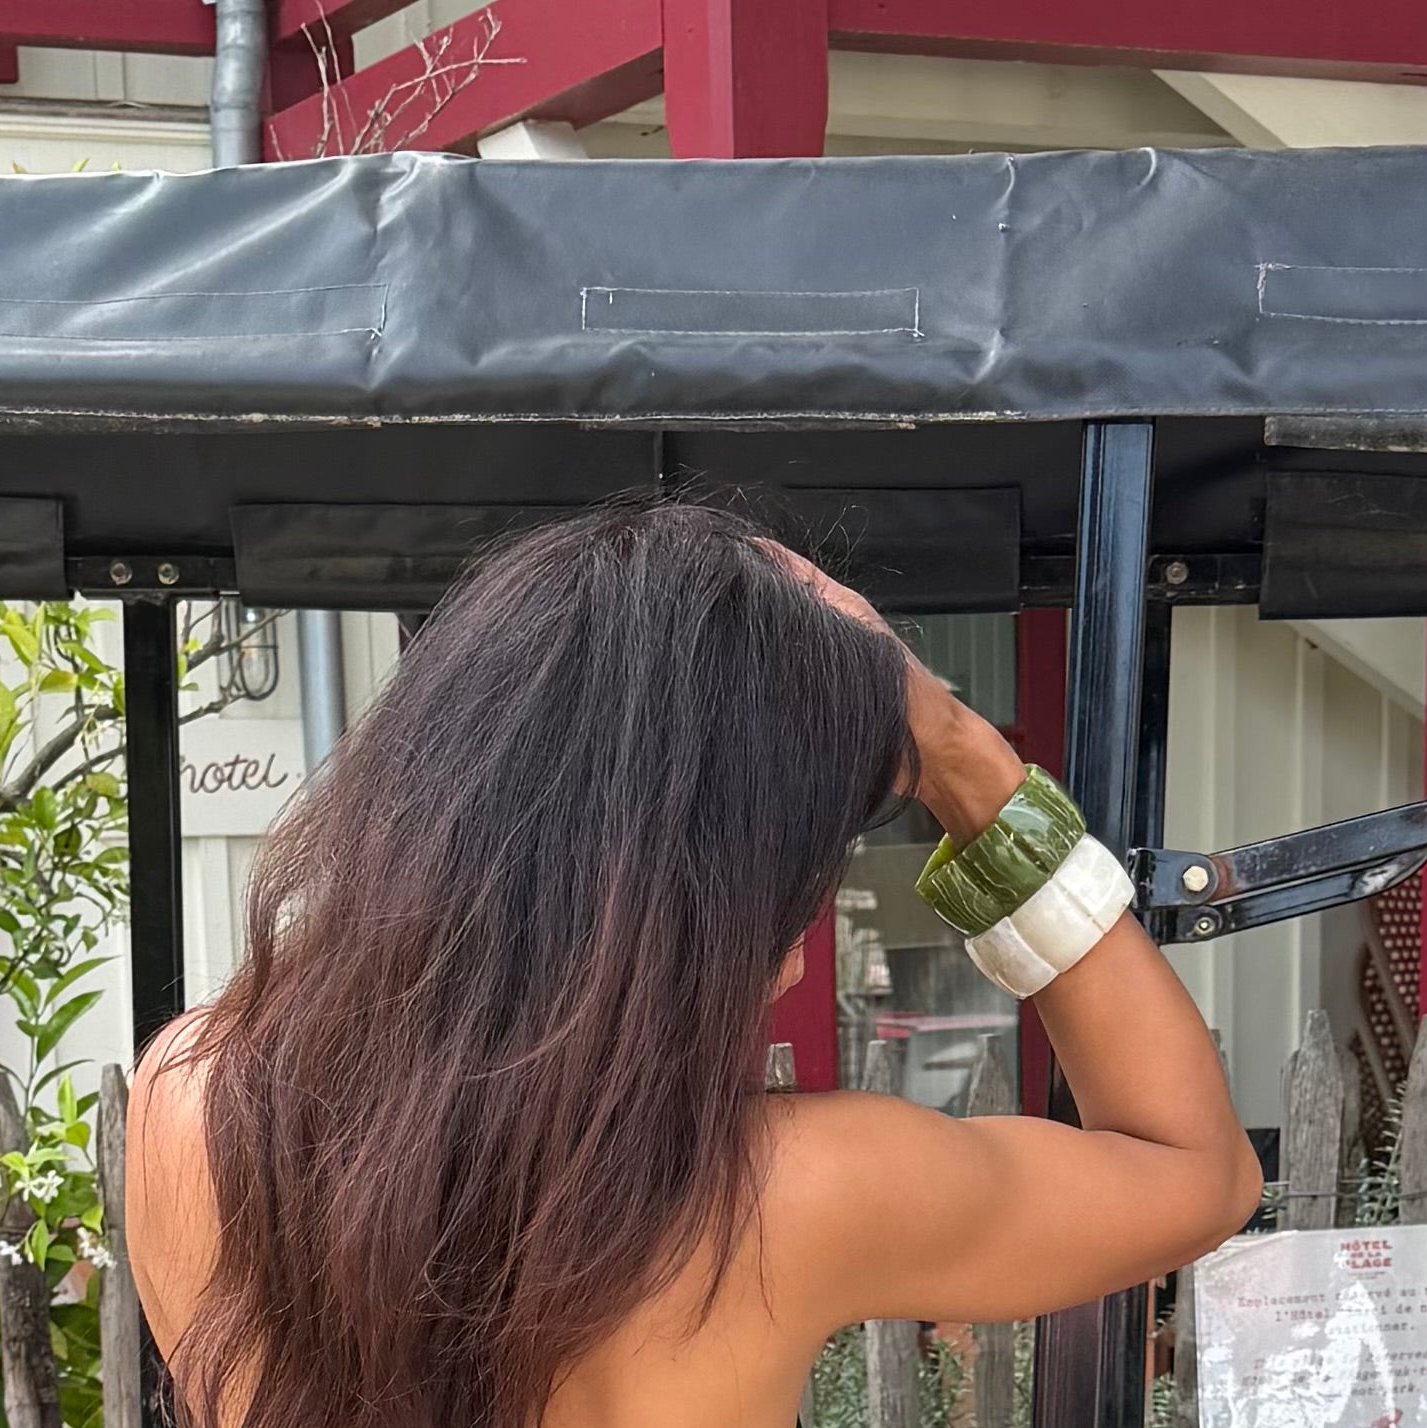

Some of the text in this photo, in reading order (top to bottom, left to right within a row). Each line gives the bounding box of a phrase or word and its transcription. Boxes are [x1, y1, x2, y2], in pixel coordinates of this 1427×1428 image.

[1340, 1240, 1392, 1252] HÔTEL
[1346, 1258, 1392, 1269] LAGE
[1238, 1293, 1324, 1308] Emplacement
[1396, 1303, 1412, 1314] de
